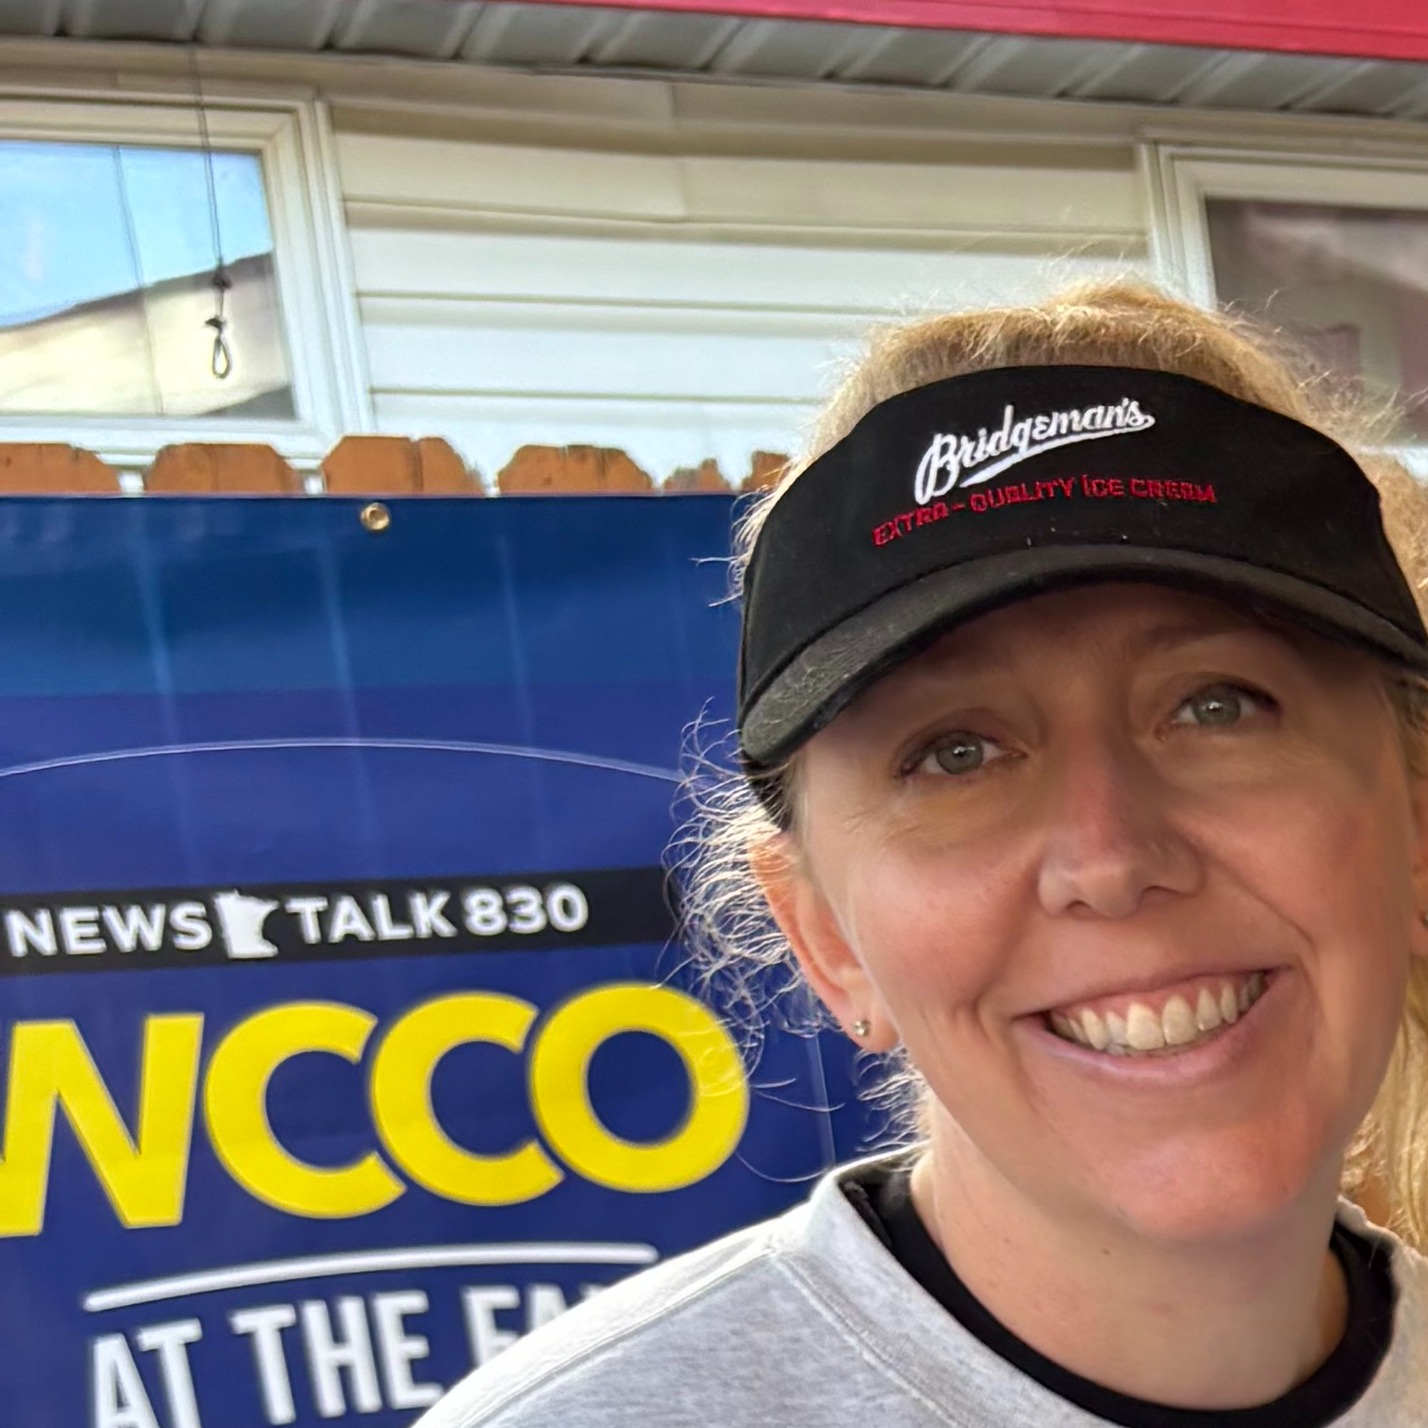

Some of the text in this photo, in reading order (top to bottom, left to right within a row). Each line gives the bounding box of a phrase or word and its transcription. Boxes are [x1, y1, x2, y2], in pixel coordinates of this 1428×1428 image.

[914, 398, 1155, 505] Bridgeman's
[1081, 474, 1125, 498] ICE
[1129, 477, 1217, 503] CREAM
[4, 884, 589, 958] NEWS TALK 830
[0, 981, 750, 1238] WCCO
[230, 1290, 444, 1425] THE
